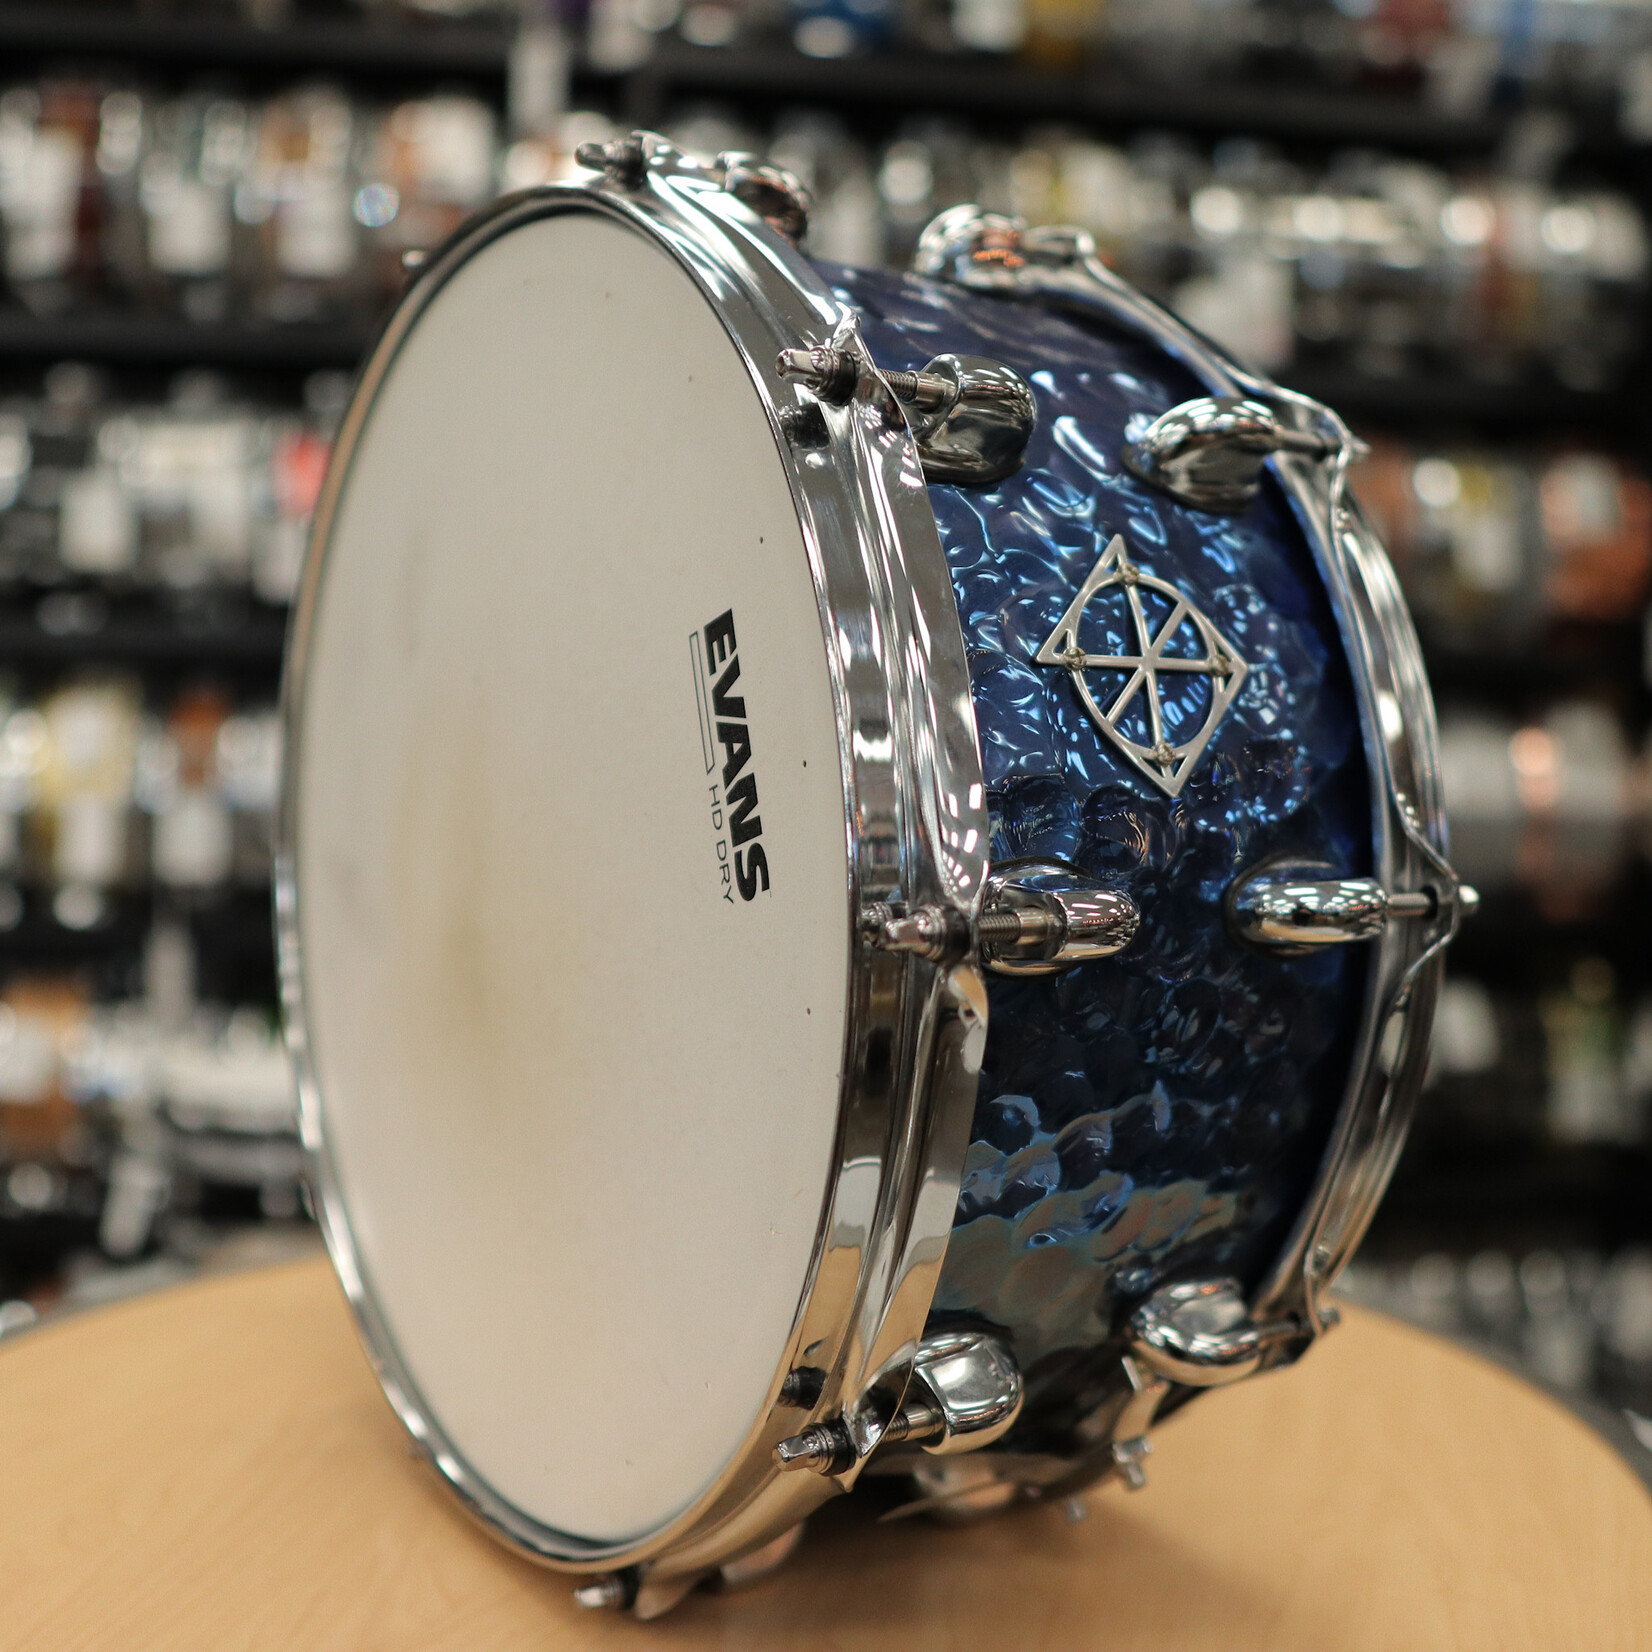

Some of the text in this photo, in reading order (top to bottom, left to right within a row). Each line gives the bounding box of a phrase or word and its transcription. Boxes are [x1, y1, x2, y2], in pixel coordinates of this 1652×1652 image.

[703, 607, 771, 902] EVANS
[708, 784, 735, 905] HD DRY
